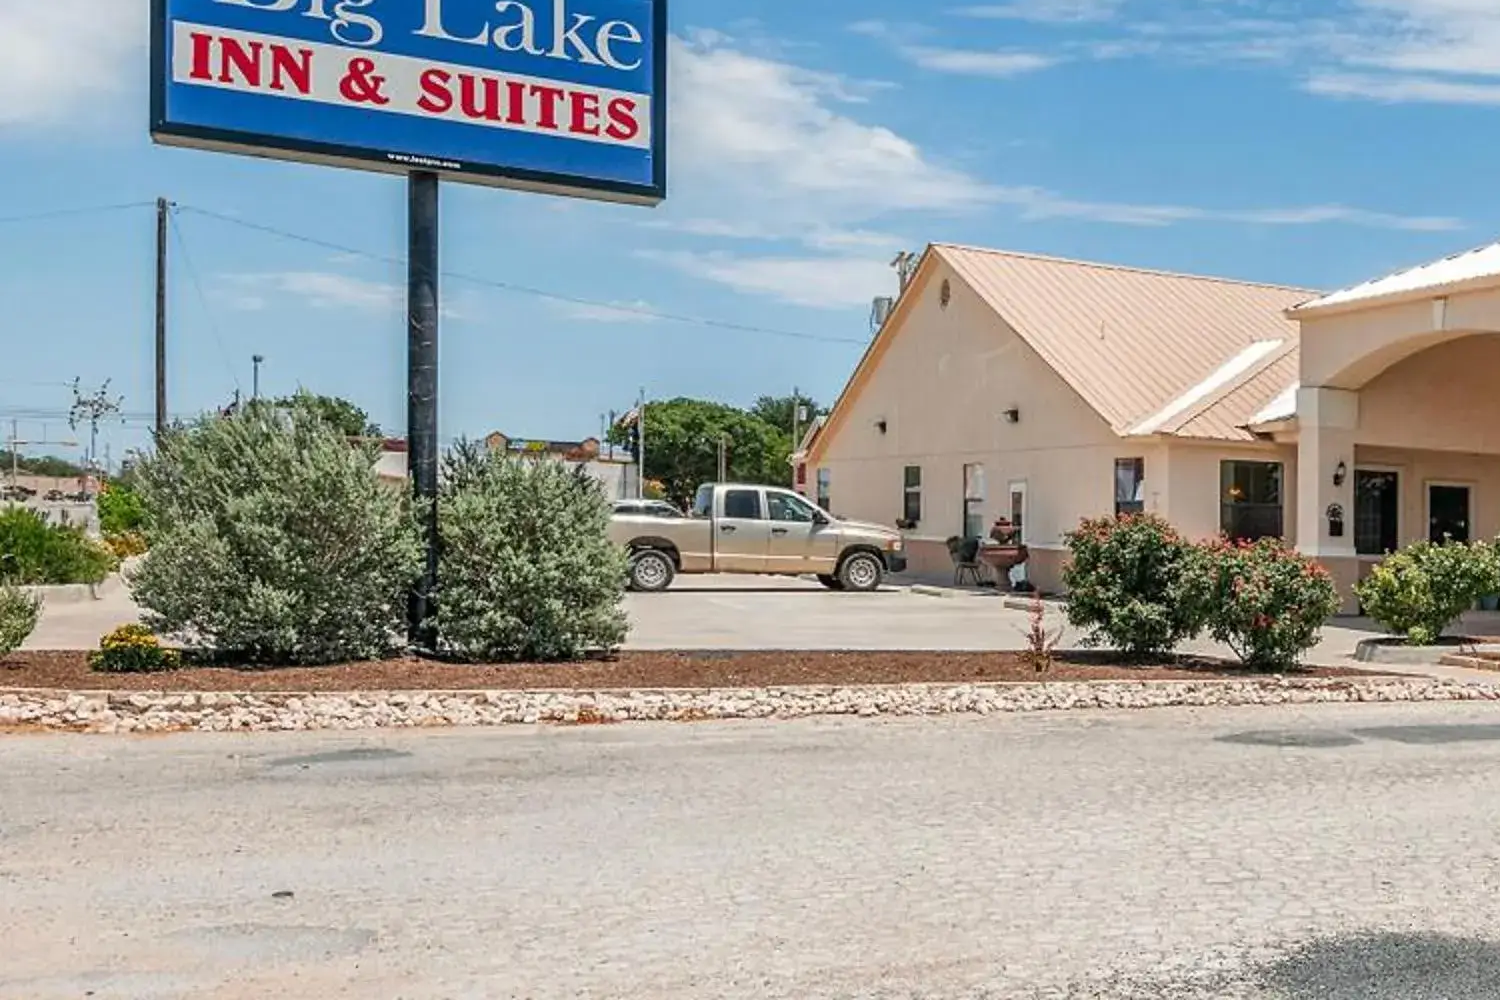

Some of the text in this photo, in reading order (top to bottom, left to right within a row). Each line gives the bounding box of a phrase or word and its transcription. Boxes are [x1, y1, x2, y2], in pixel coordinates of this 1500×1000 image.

[189, 32, 640, 141] INN & SUITES
